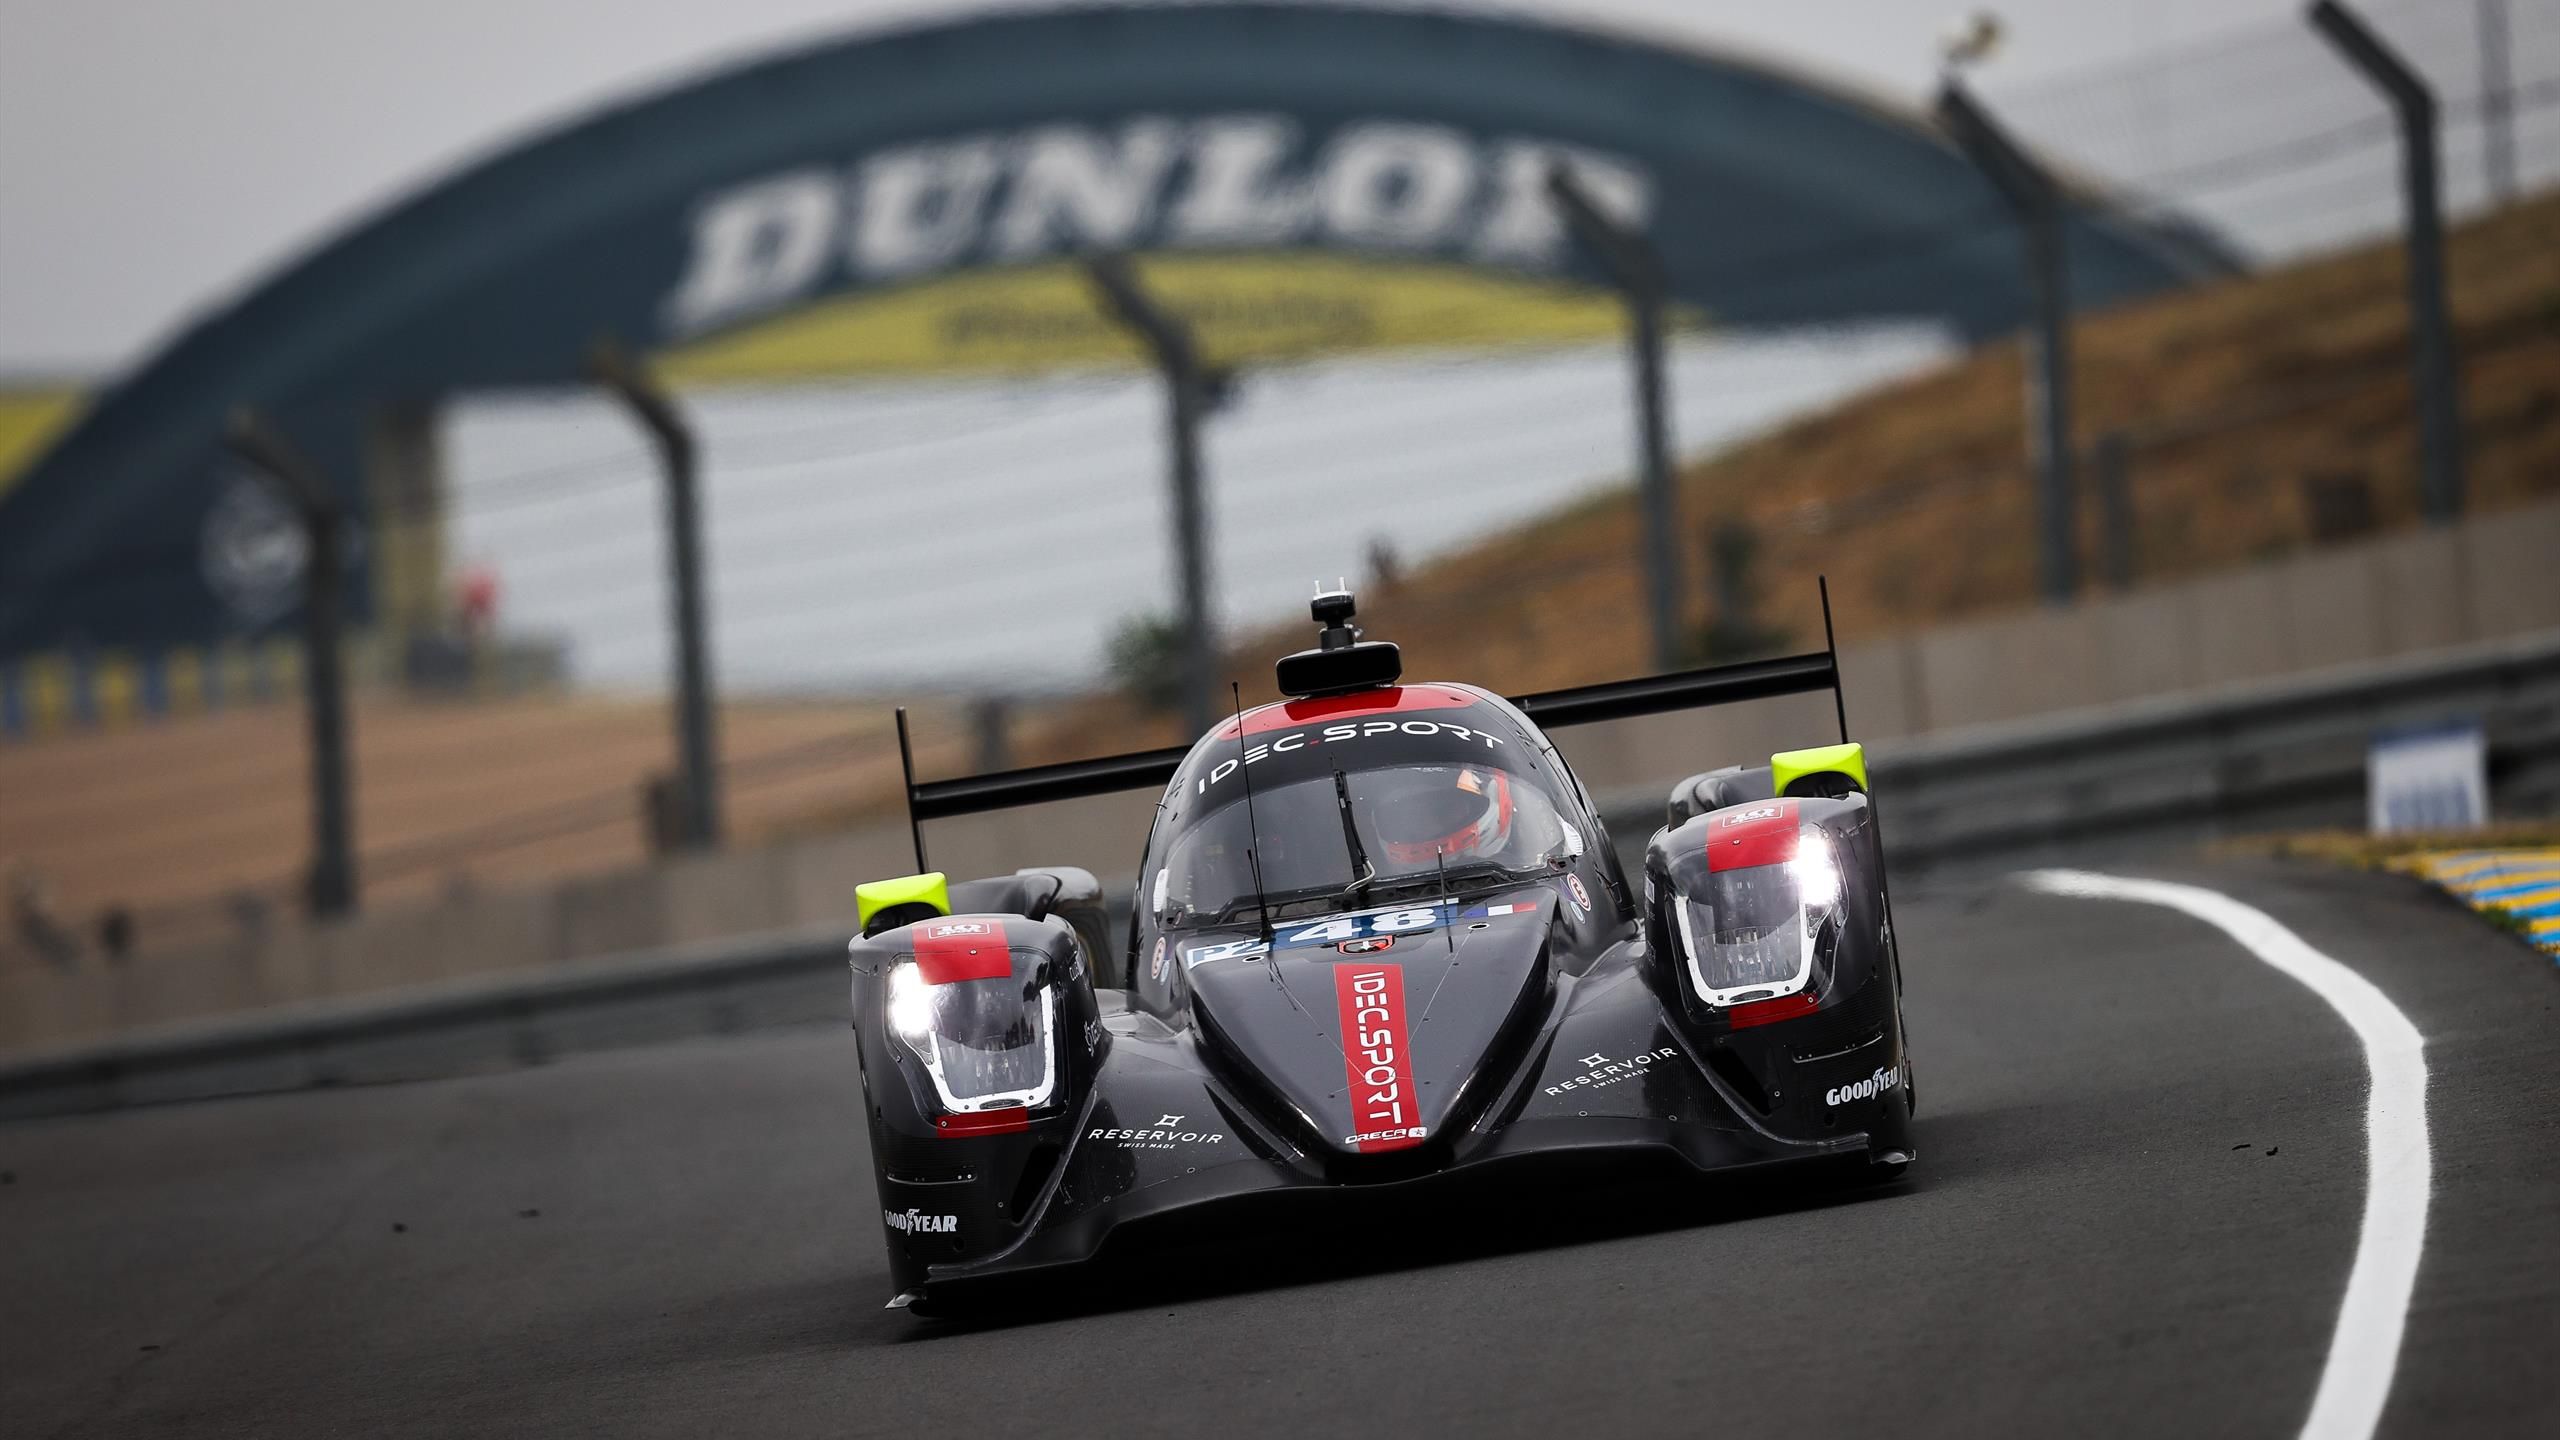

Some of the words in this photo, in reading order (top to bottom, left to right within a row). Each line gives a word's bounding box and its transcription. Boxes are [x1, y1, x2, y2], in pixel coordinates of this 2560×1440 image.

[658, 112, 1656, 332] DUNLOP
[1289, 908, 1438, 942] 48
[1353, 971, 1402, 1124] IDEC.SPORT
[1545, 1047, 1678, 1096] RESERVOIR
[1592, 1076, 1621, 1089] SWISS
[1623, 1067, 1651, 1079] MADE
[1826, 1066, 1899, 1106] GOODYEAR
[1088, 1128, 1224, 1144] RESERVOIR
[1148, 1142, 1176, 1150] MADE
